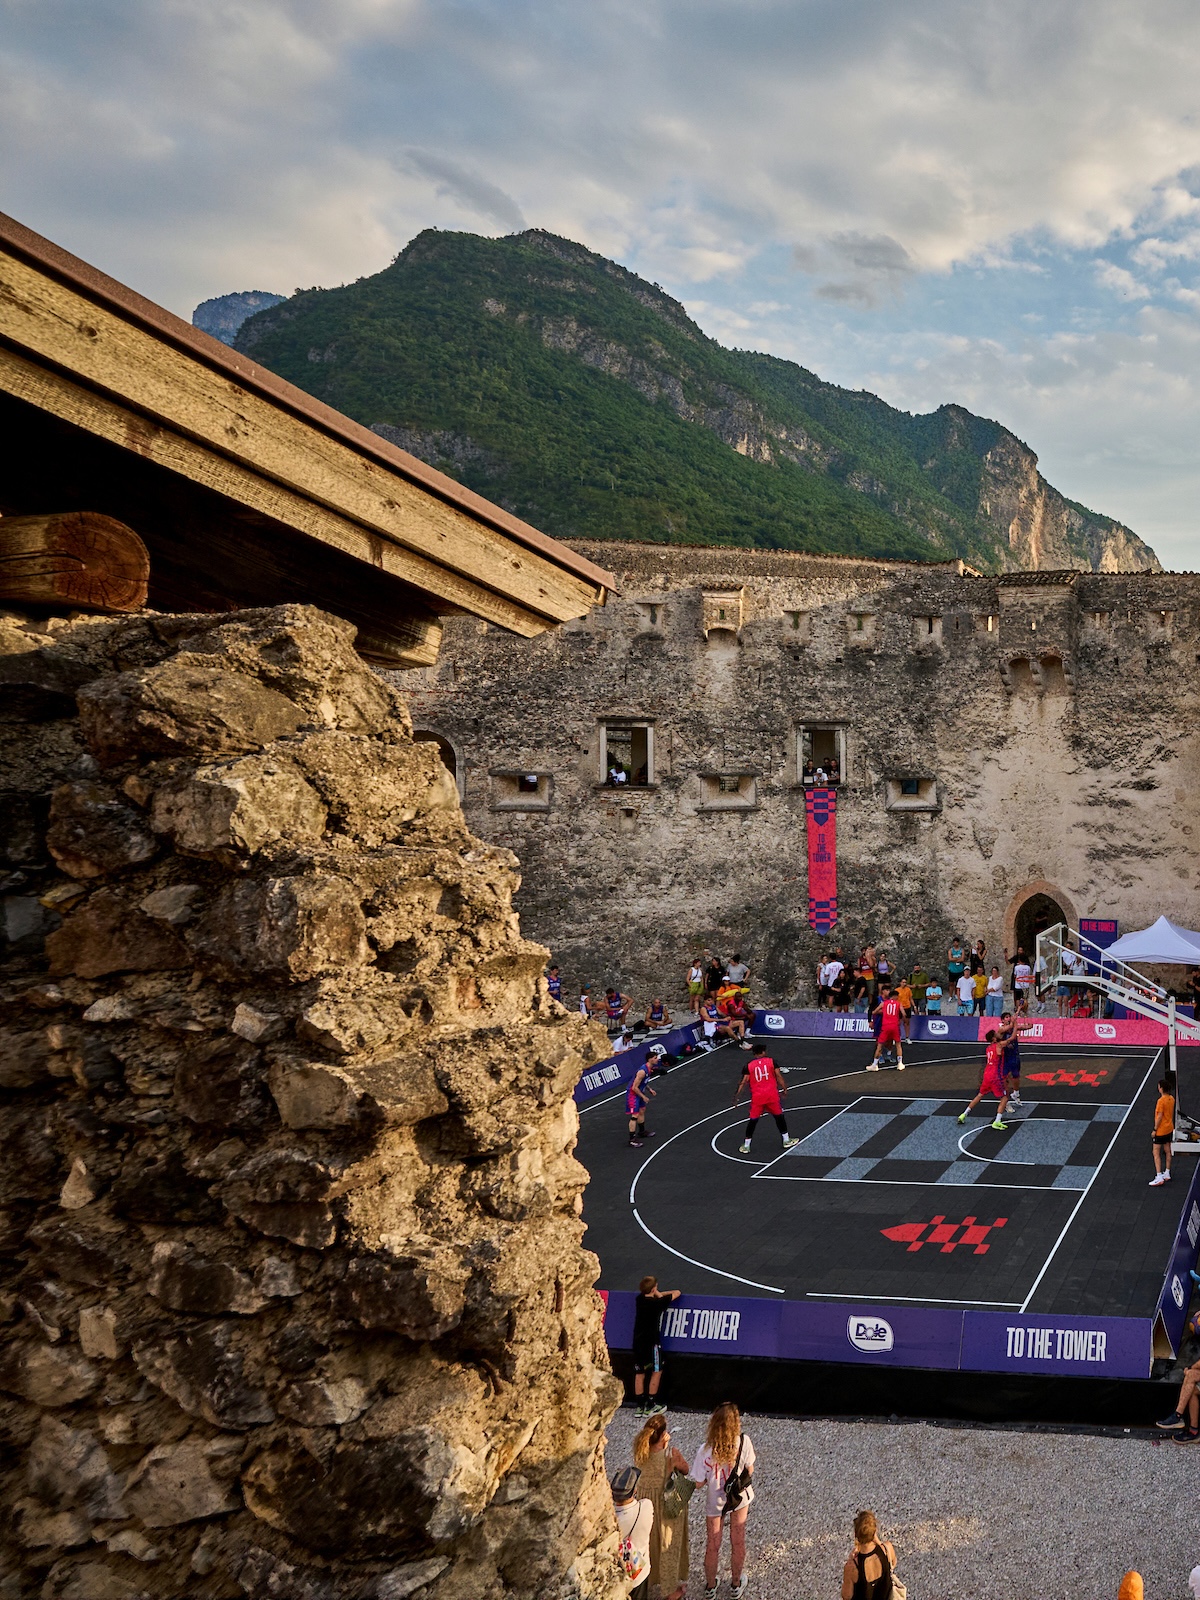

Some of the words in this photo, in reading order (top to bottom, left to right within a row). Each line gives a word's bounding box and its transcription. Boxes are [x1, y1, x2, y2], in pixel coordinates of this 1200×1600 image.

[818, 833, 825, 843] TO
[812, 852, 831, 862] TOWER
[886, 1003, 897, 1016] 01
[833, 1018, 843, 1031] TO
[843, 1018, 856, 1032] THE
[855, 1018, 874, 1032] TOW
[754, 1065, 769, 1082] 04
[664, 1308, 691, 1338] THE
[691, 1309, 740, 1340] TOWER
[855, 1323, 887, 1338] Dole
[1006, 1327, 1025, 1357] TO
[1027, 1328, 1054, 1359] THE
[1056, 1329, 1107, 1361] TOWER
